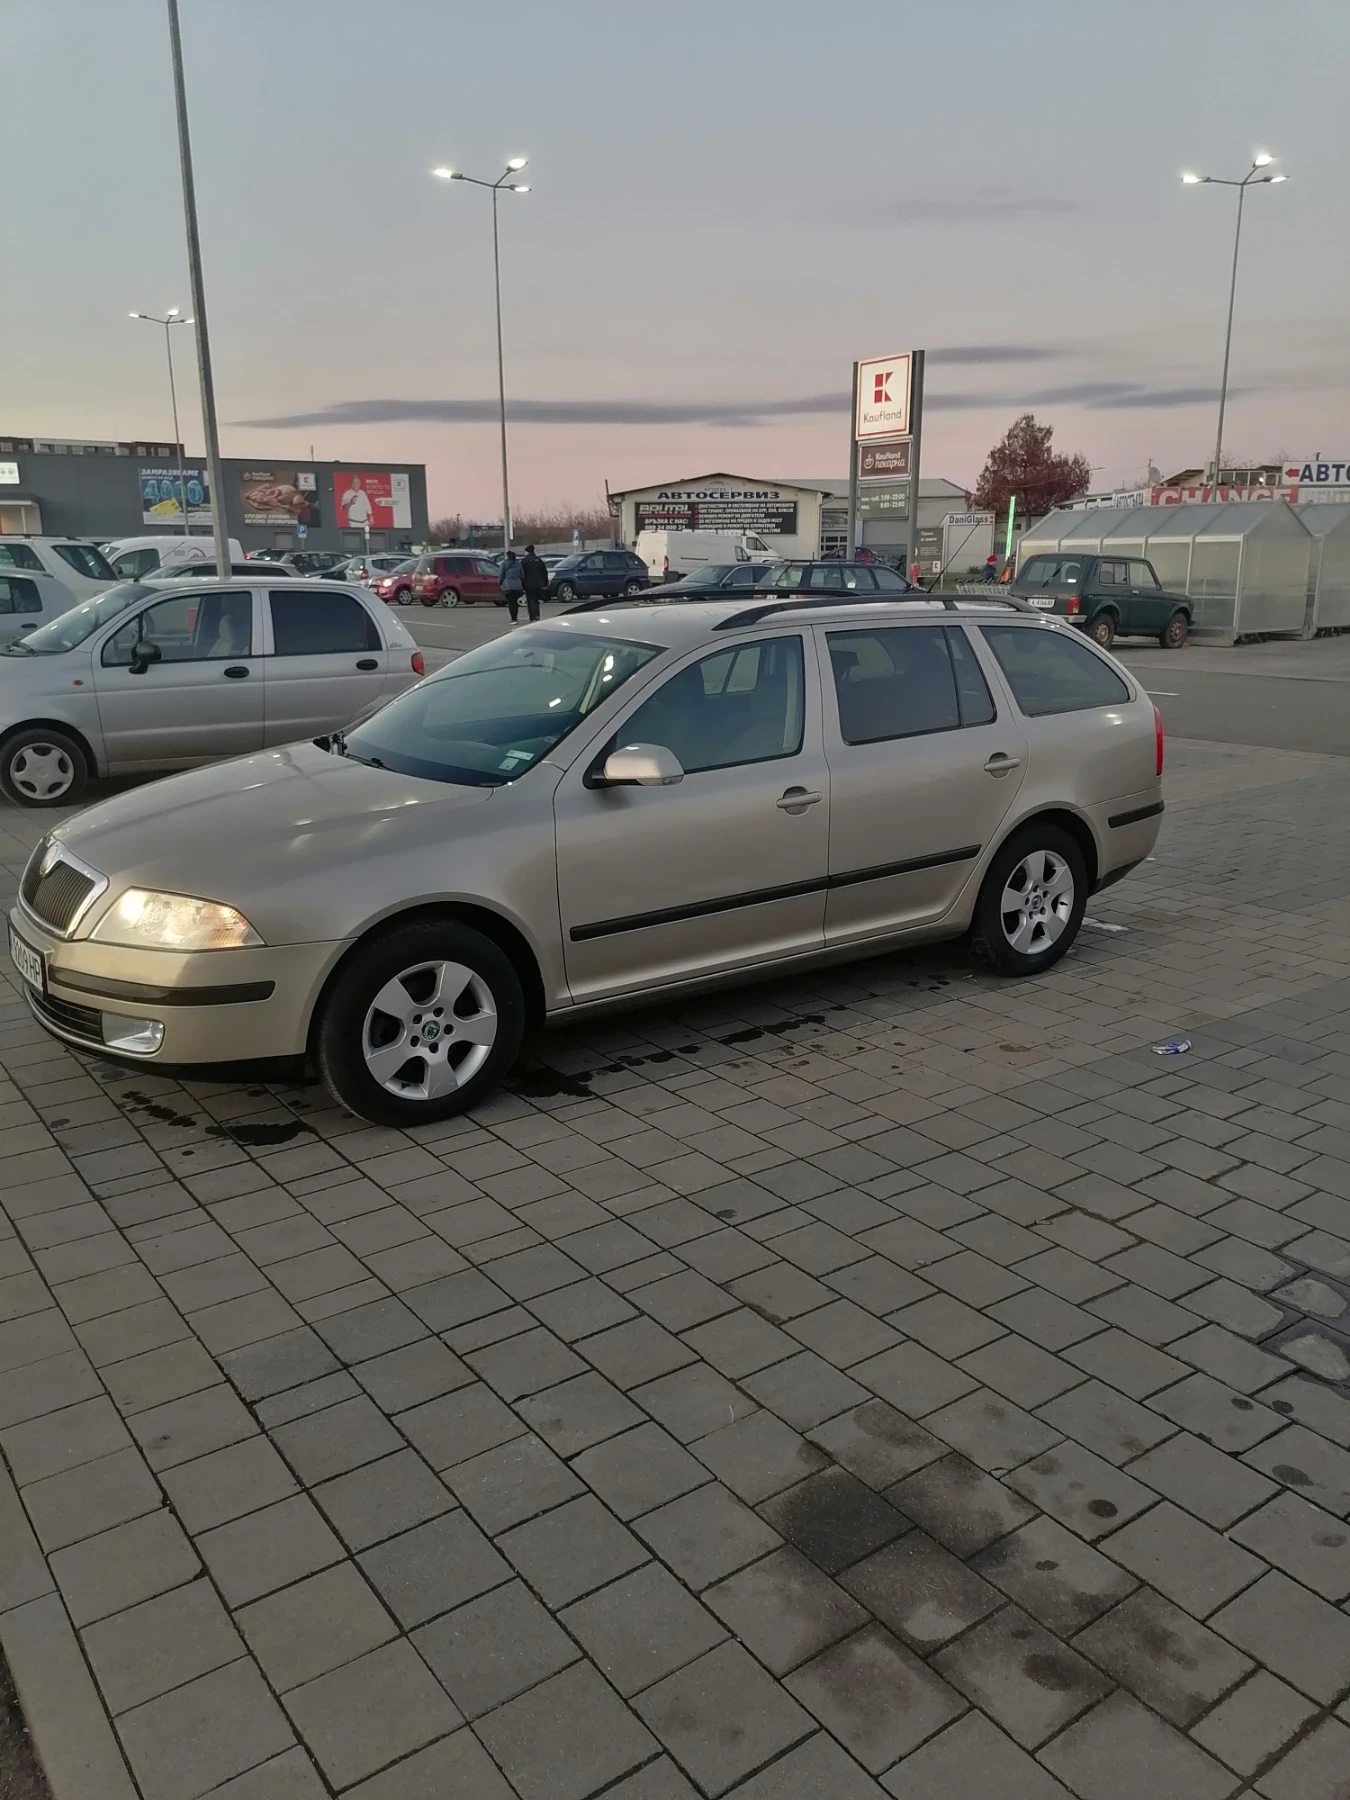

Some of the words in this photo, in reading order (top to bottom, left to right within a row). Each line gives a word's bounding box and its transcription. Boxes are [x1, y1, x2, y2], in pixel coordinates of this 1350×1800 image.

[863, 408, 902, 424] Kaufland
[875, 451, 901, 461] Kaufland
[875, 459, 906, 470] пекарна
[1299, 463, 1350, 482] АВТ
[657, 491, 780, 500] АВТОСЕРВИЗ
[639, 504, 691, 514] BRUTAL
[948, 515, 989, 524] DaniGlass
